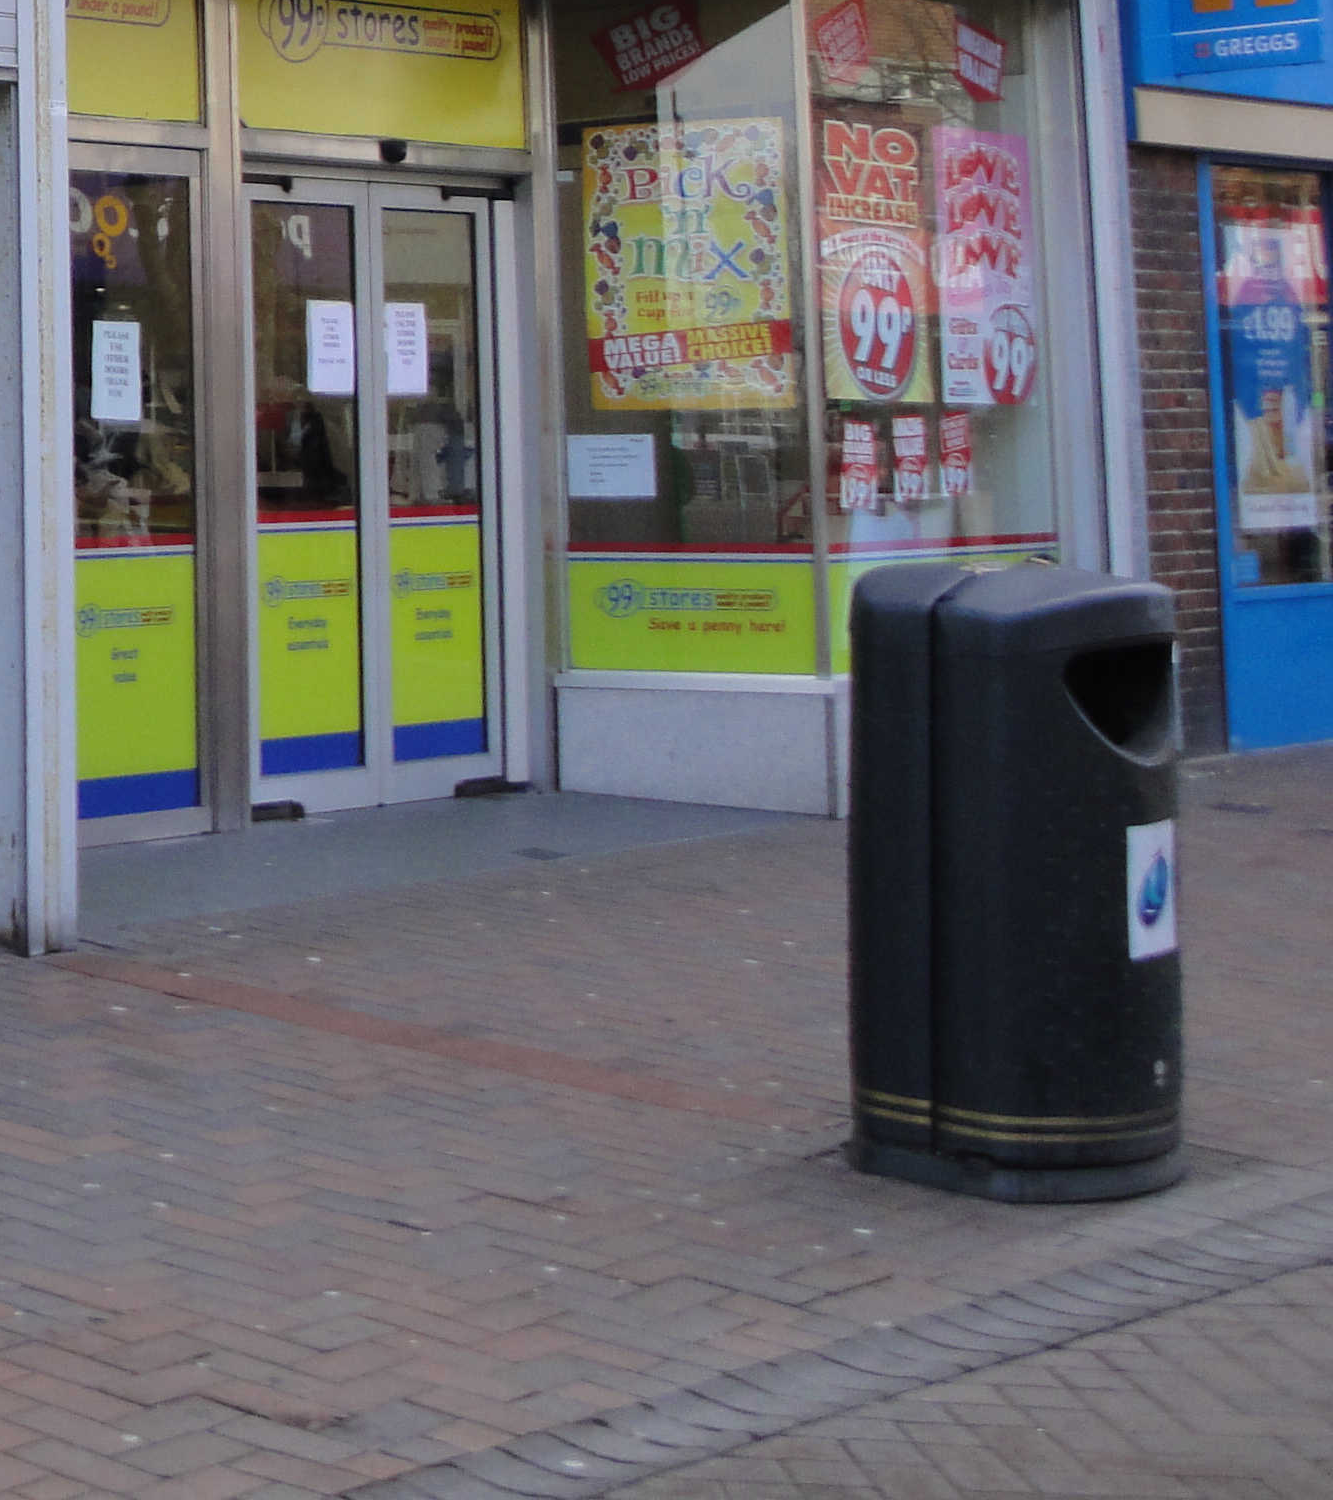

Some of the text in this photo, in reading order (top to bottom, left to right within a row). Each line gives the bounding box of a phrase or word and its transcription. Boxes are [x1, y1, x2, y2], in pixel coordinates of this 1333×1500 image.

[121, 0, 159, 19] pound!
[336, 4, 420, 46] stores
[609, 4, 681, 53] BIG
[1214, 32, 1298, 56] GREGGS
[615, 23, 694, 72] BRANDS
[621, 40, 702, 85] LOW PRICES!
[823, 119, 918, 167] NO
[823, 156, 919, 200] VAT
[625, 236, 750, 281] mix
[603, 323, 771, 356] MEGA MASSIVE
[604, 337, 772, 370] VALUE! CHOICE!
[857, 366, 898, 388] OR LESS
[649, 591, 712, 607] stores
[647, 618, 682, 631] Save
[687, 621, 697, 631] a
[702, 620, 743, 635] penny
